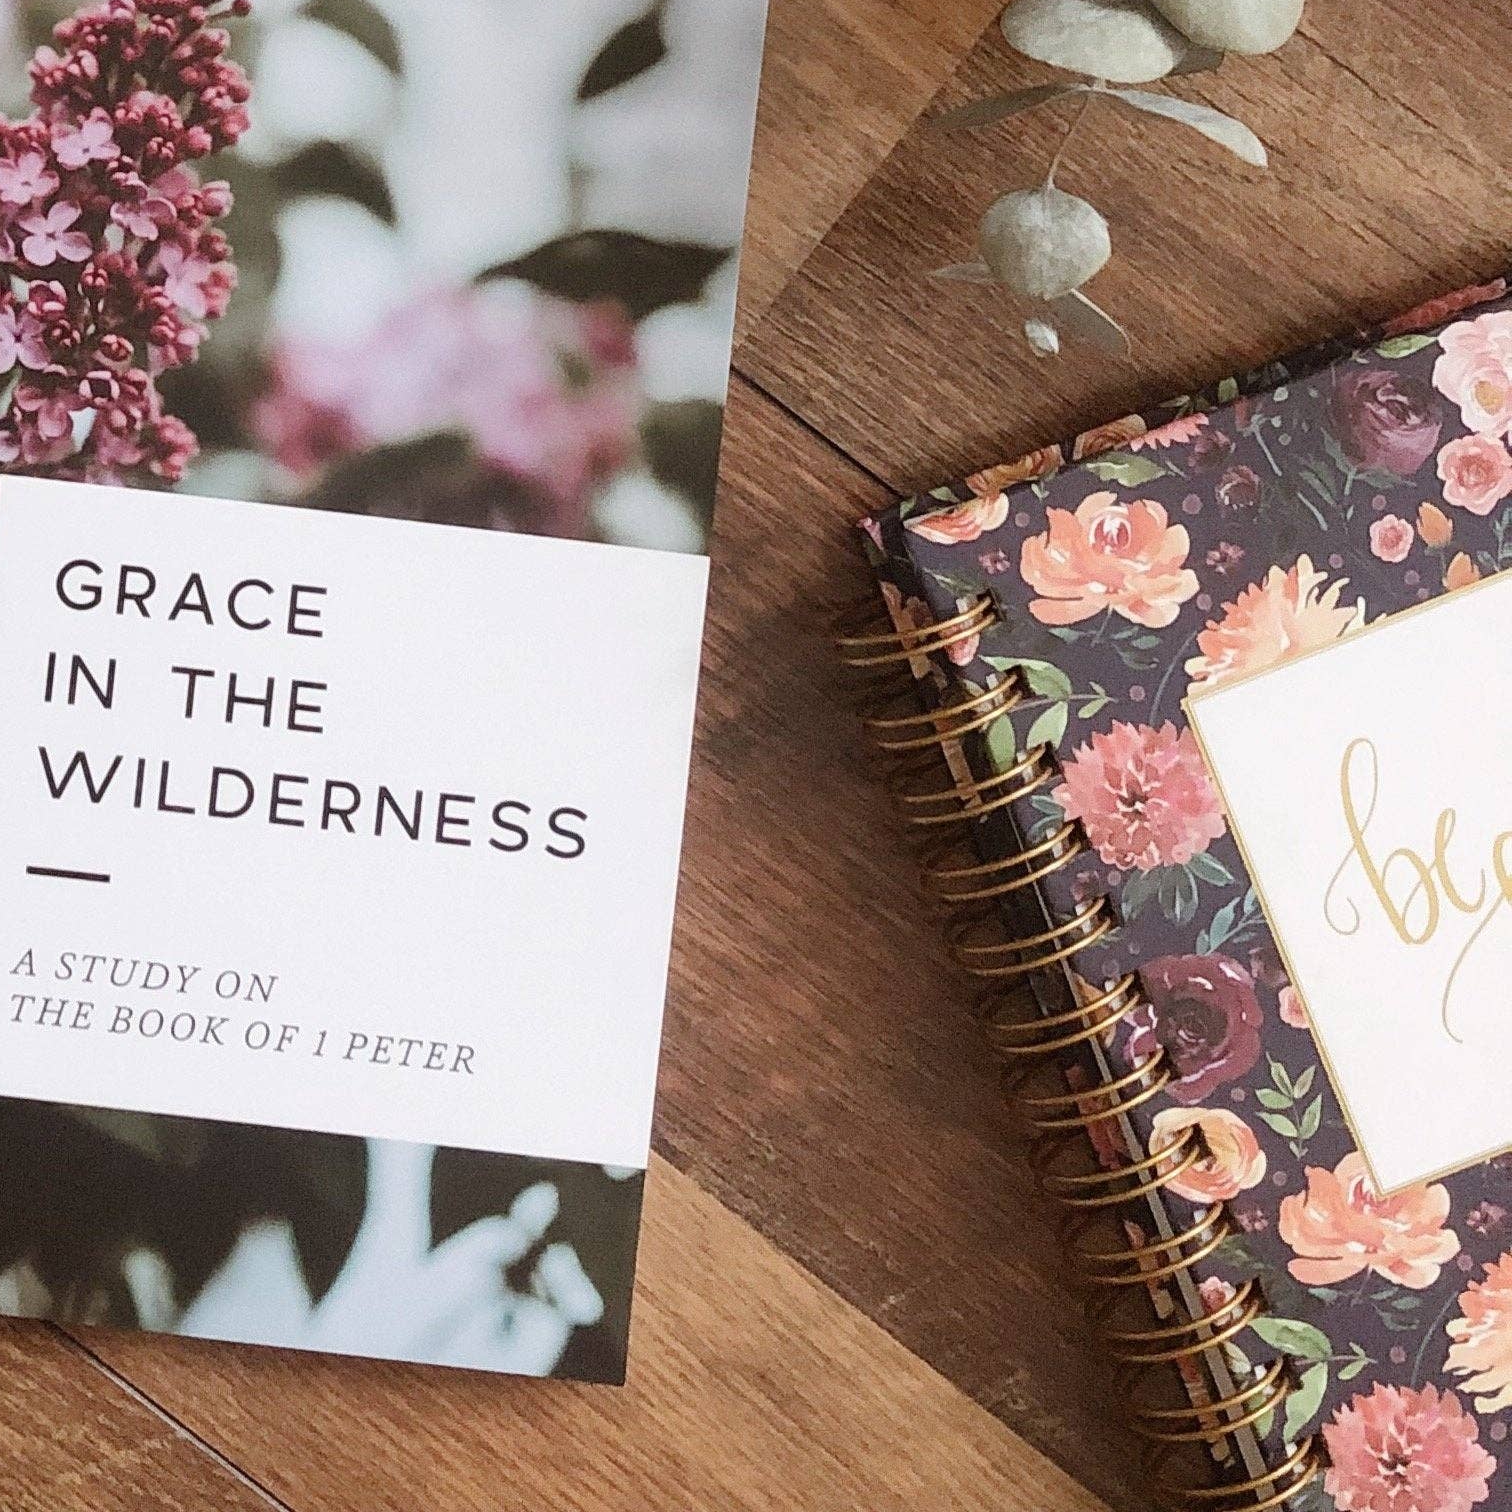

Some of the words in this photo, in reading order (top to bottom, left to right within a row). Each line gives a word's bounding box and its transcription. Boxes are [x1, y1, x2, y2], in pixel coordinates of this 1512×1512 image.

[55, 559, 327, 638] GRACE
[44, 651, 117, 710] IN
[171, 666, 328, 734] THE
[38, 746, 588, 859] WILDERNESS
[9, 947, 36, 977] A
[54, 952, 202, 994] STUDY
[215, 970, 279, 1003] ON
[11, 993, 95, 1030] THE
[107, 1005, 230, 1046] BOOK
[244, 1021, 300, 1053] OF
[312, 1030, 327, 1057] 1
[342, 1032, 475, 1075] PETER
